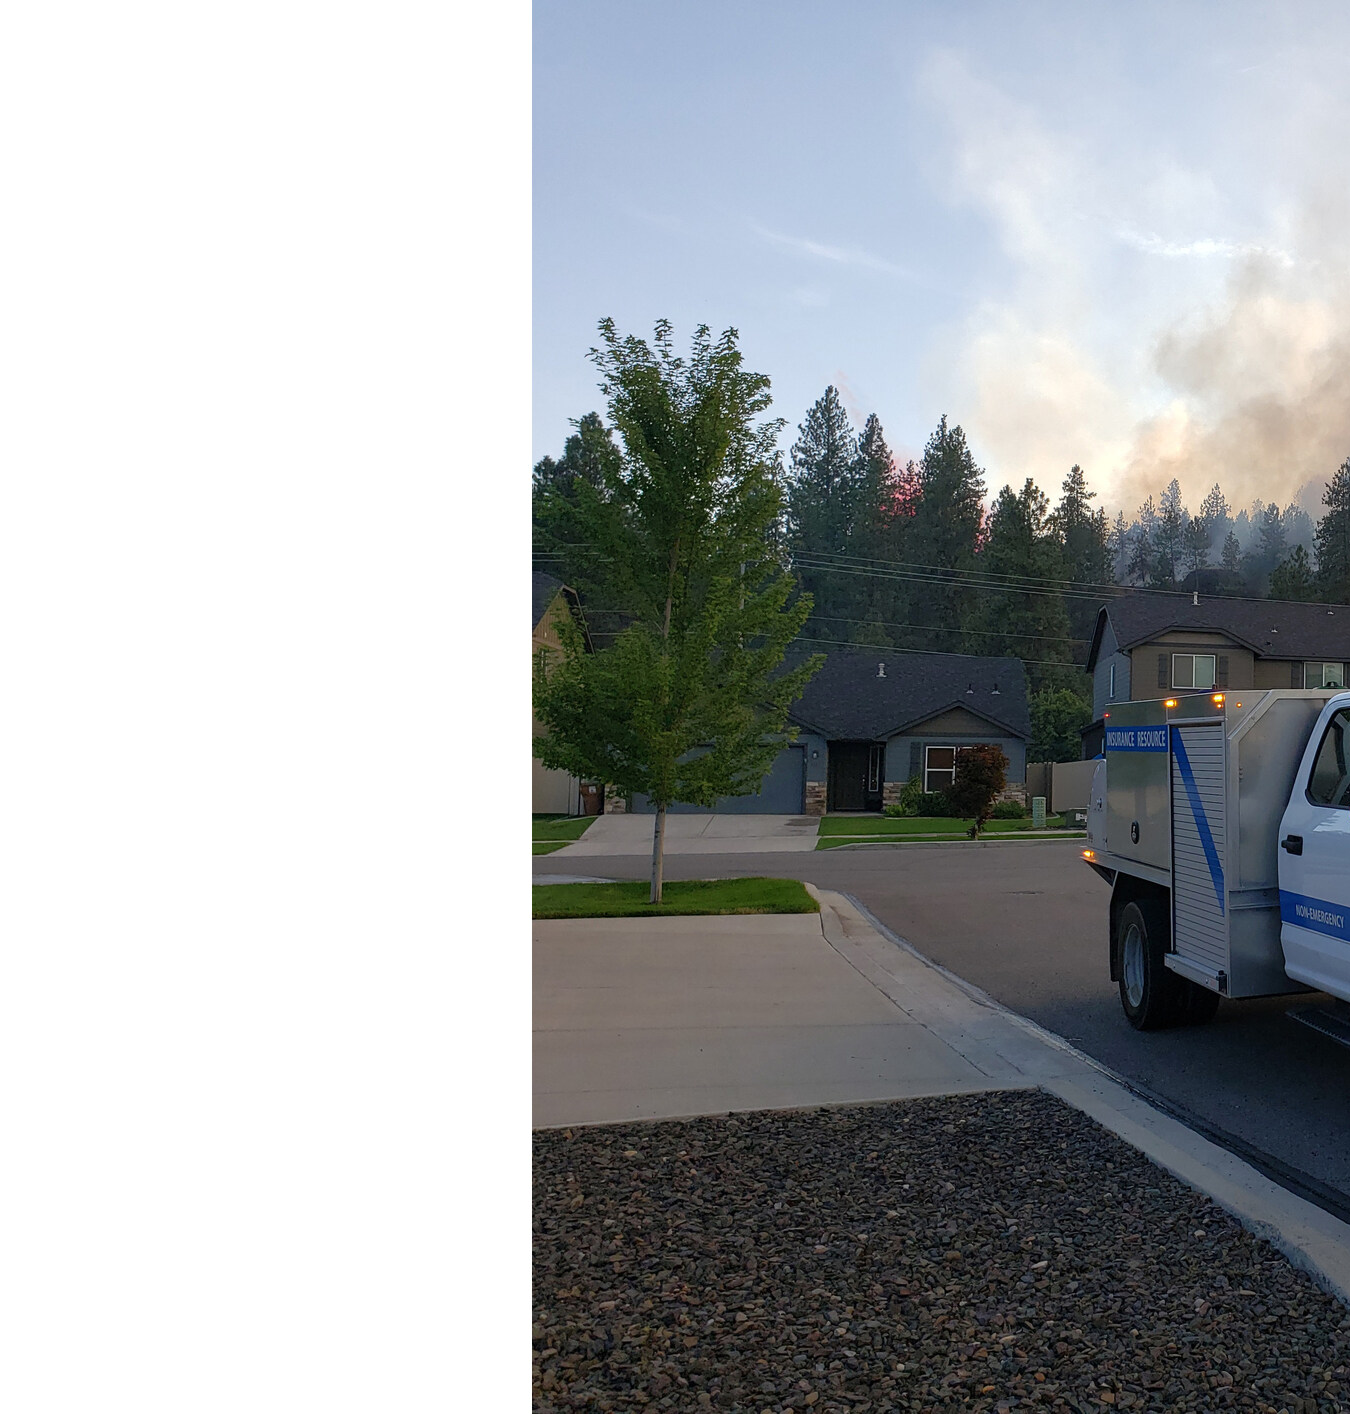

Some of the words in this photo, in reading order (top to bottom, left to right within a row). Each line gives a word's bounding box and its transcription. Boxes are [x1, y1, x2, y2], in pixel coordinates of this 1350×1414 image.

[1106, 731, 1135, 747] INSURANCE
[1137, 730, 1166, 747] RESOURCE
[1295, 903, 1345, 929] NON-EMERGENCY
